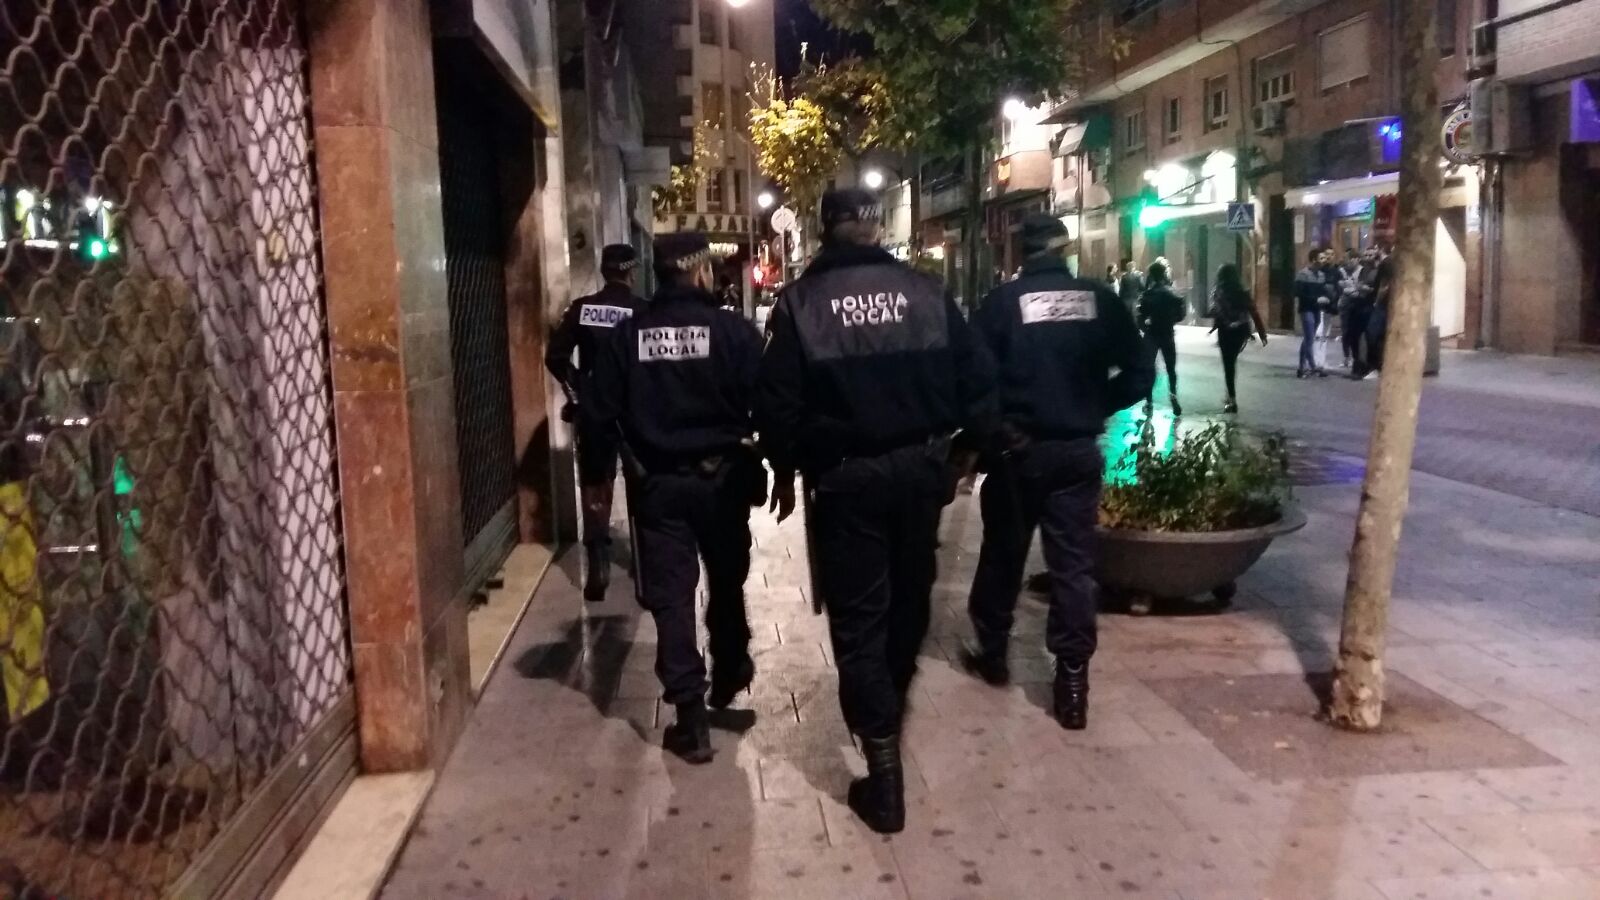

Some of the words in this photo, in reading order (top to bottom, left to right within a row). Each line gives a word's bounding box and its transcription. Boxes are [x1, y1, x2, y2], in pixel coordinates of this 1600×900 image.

[831, 292, 908, 314] POLICIA
[842, 306, 903, 327] LOCAL
[642, 329, 706, 342] POLICIA
[648, 343, 700, 356] LOCAL
